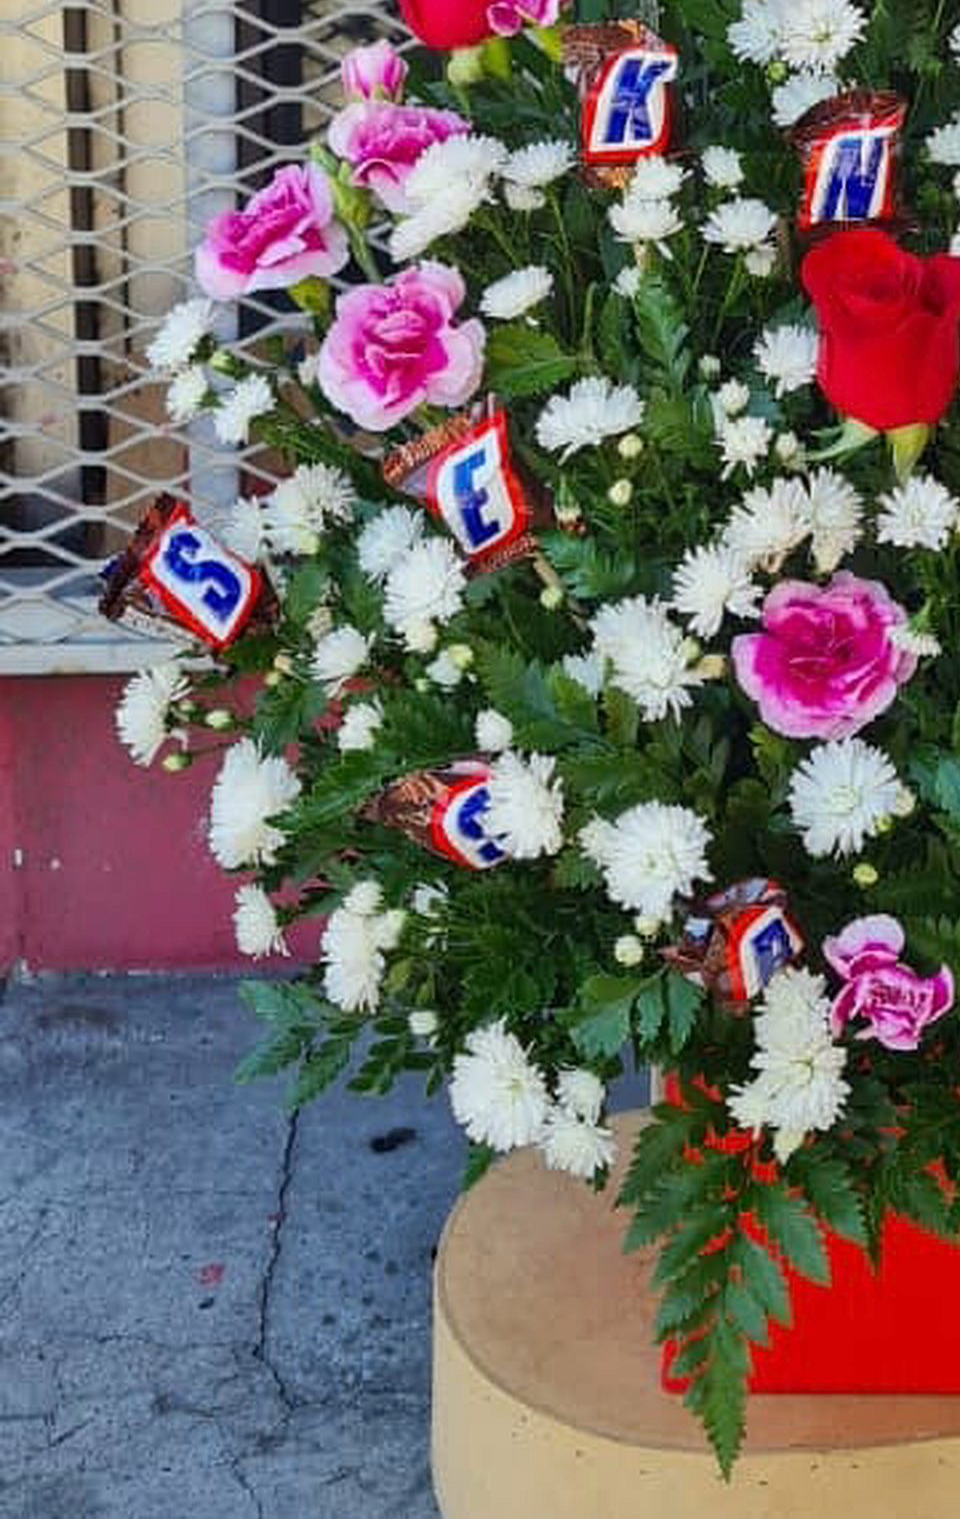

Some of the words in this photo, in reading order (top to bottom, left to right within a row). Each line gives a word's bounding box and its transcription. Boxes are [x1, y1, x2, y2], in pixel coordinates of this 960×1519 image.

[604, 58, 672, 145] K
[820, 135, 887, 220] N
[452, 447, 501, 547] E
[161, 530, 243, 624] S
